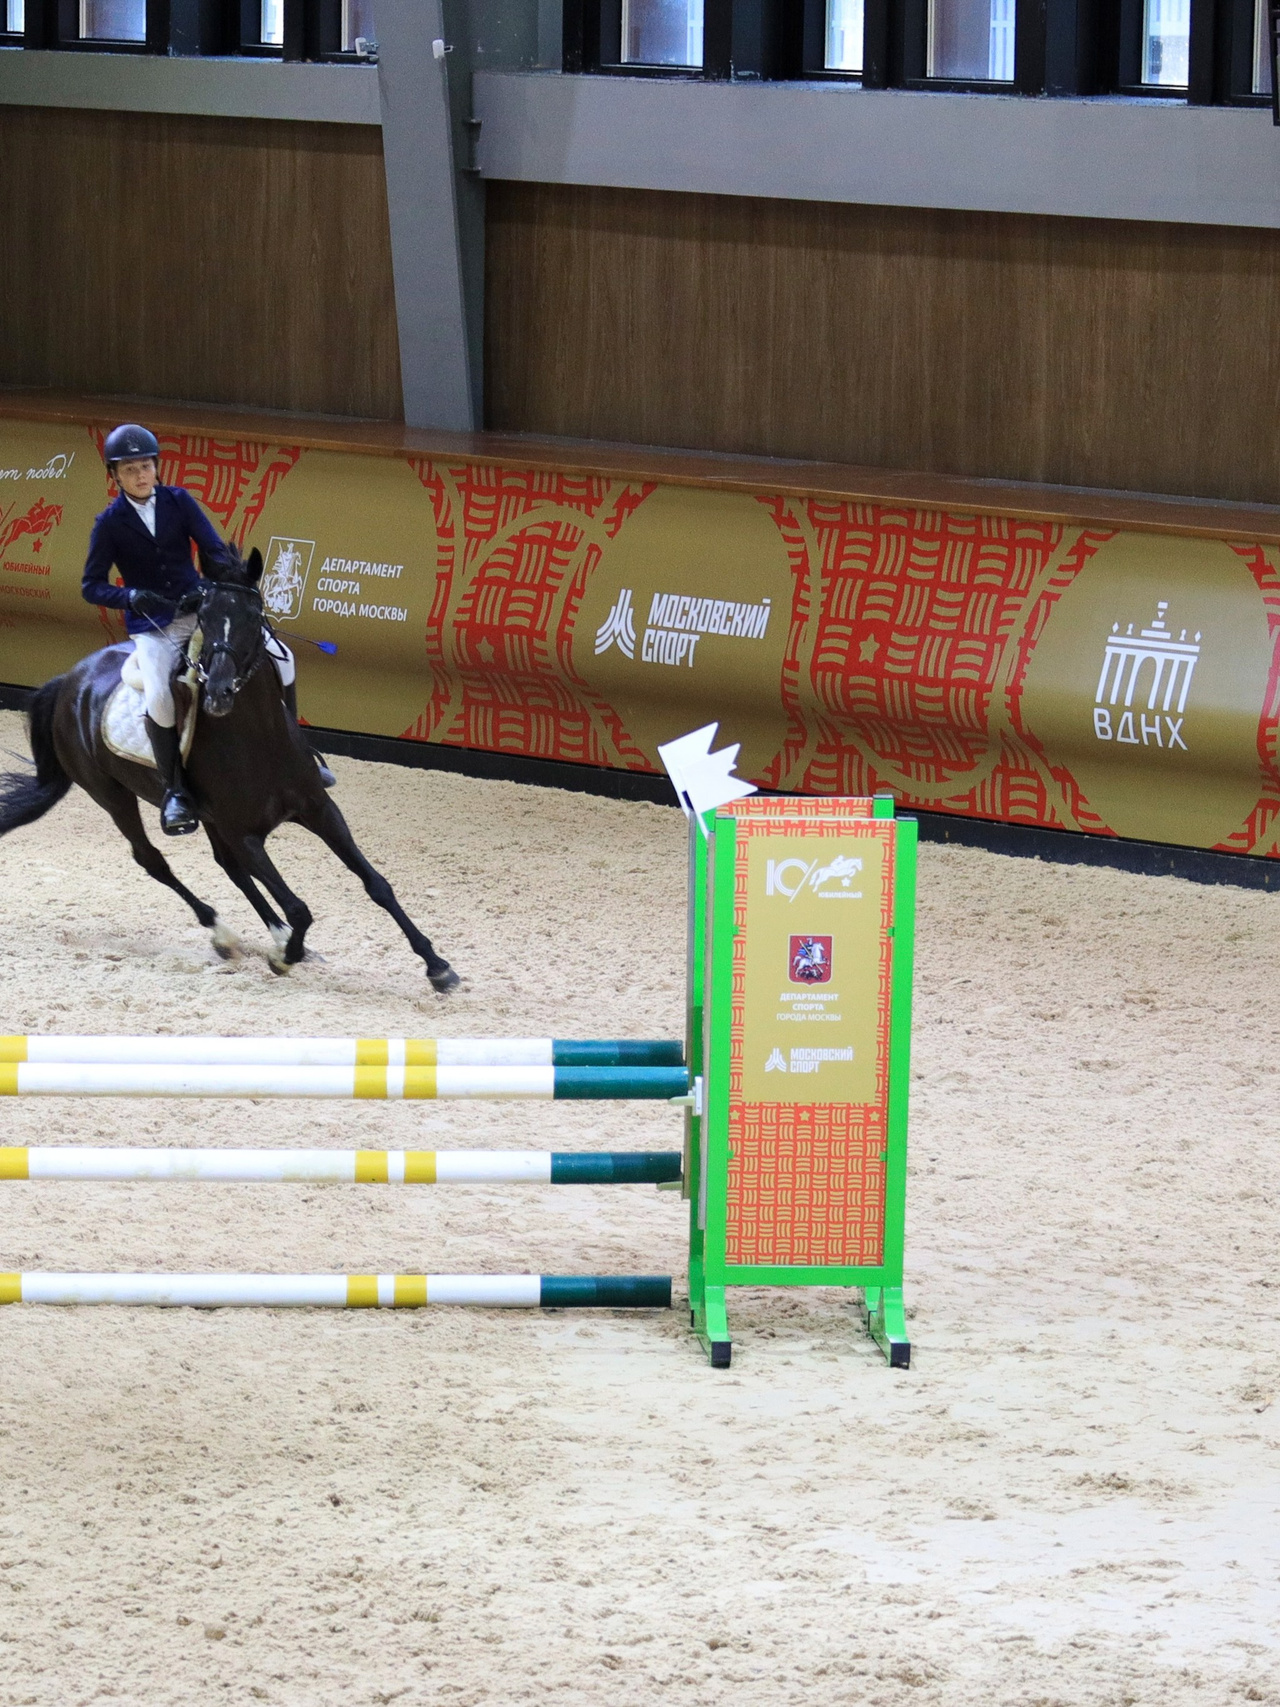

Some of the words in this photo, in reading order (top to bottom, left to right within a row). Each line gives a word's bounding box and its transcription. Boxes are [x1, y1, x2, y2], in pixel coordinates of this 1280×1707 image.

[26, 452, 75, 481] побед!
[3, 561, 51, 576] ЮБИЛЕЙНЫЙ
[321, 557, 404, 579] ДЕПАРТАМЕНТ
[317, 577, 361, 595] СПОРТА
[313, 598, 356, 618] ГОРОДА
[358, 604, 408, 622] МОСКВЫ
[647, 592, 771, 639] МОСКОВСКИЙ
[641, 628, 700, 668] СПОРТ
[1093, 707, 1188, 751] ВДНХ
[818, 891, 863, 899] ЮБИЛЕЙНЫЙ
[780, 993, 839, 1002] ДЕПАРТАМЕНТ
[792, 1003, 825, 1011] СПОРТА
[776, 1013, 806, 1022] ГОРОДА
[808, 1014, 842, 1022] МОСКВЫ
[790, 1047, 853, 1061] МОСКОВСКИЙ
[790, 1061, 819, 1073] СПОРТ
